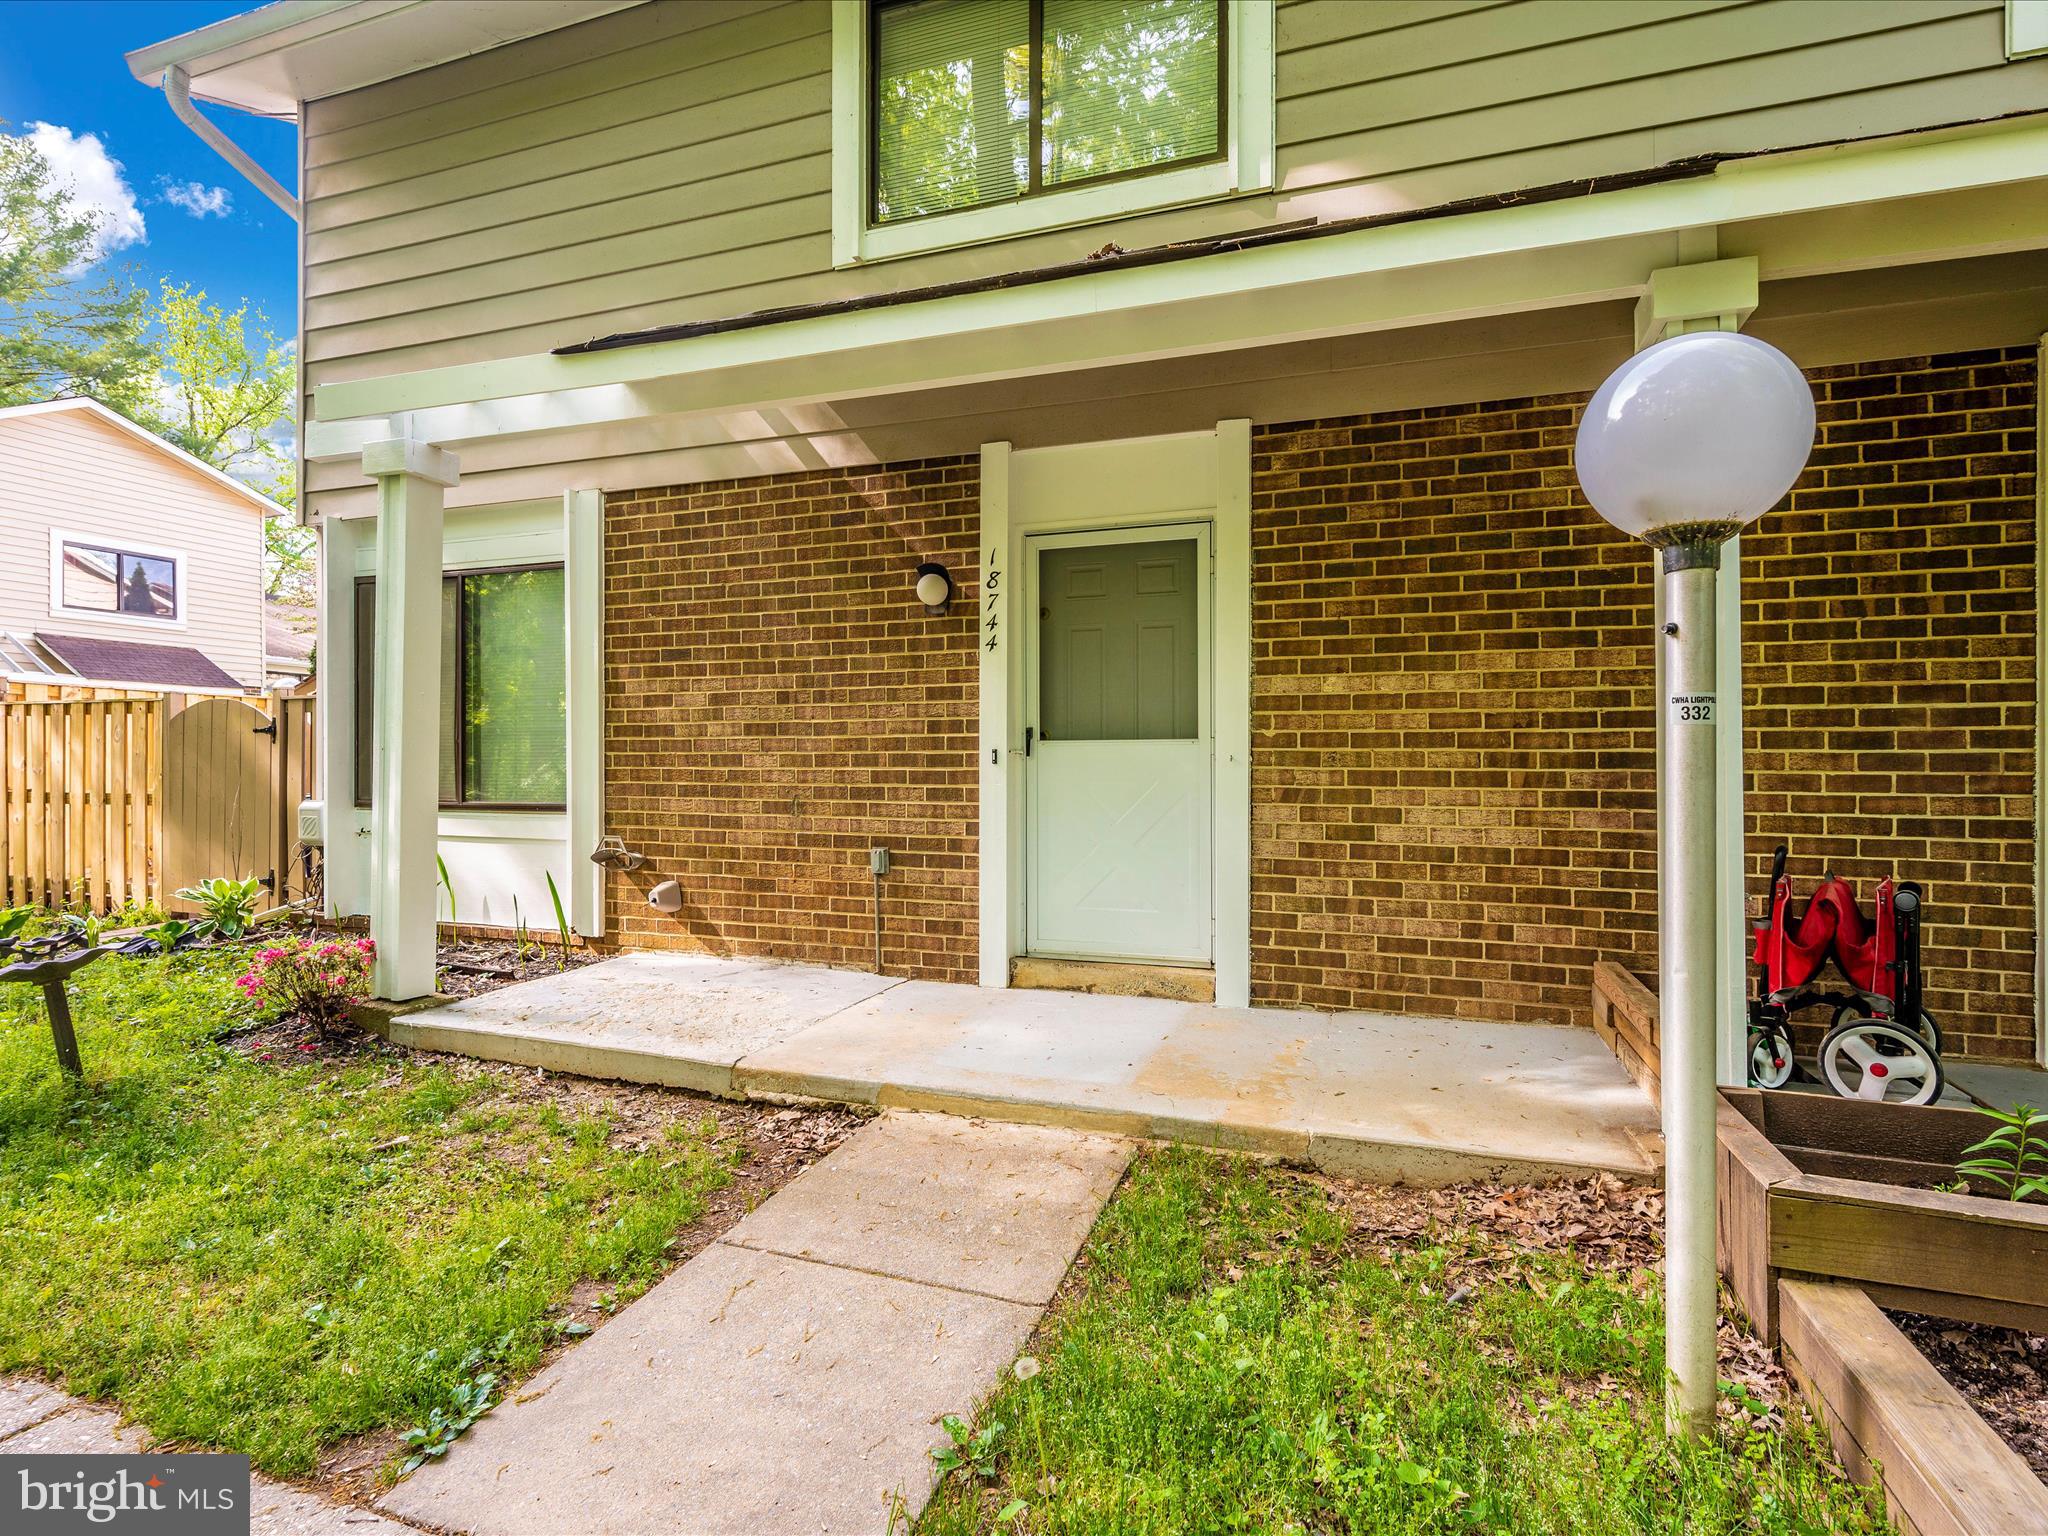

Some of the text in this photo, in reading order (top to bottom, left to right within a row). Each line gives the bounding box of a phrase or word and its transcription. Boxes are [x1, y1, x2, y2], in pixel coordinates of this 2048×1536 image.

[985, 547, 1001, 652] 18744
[1671, 696, 1689, 704] CWHA
[1681, 705, 1710, 720] 332
